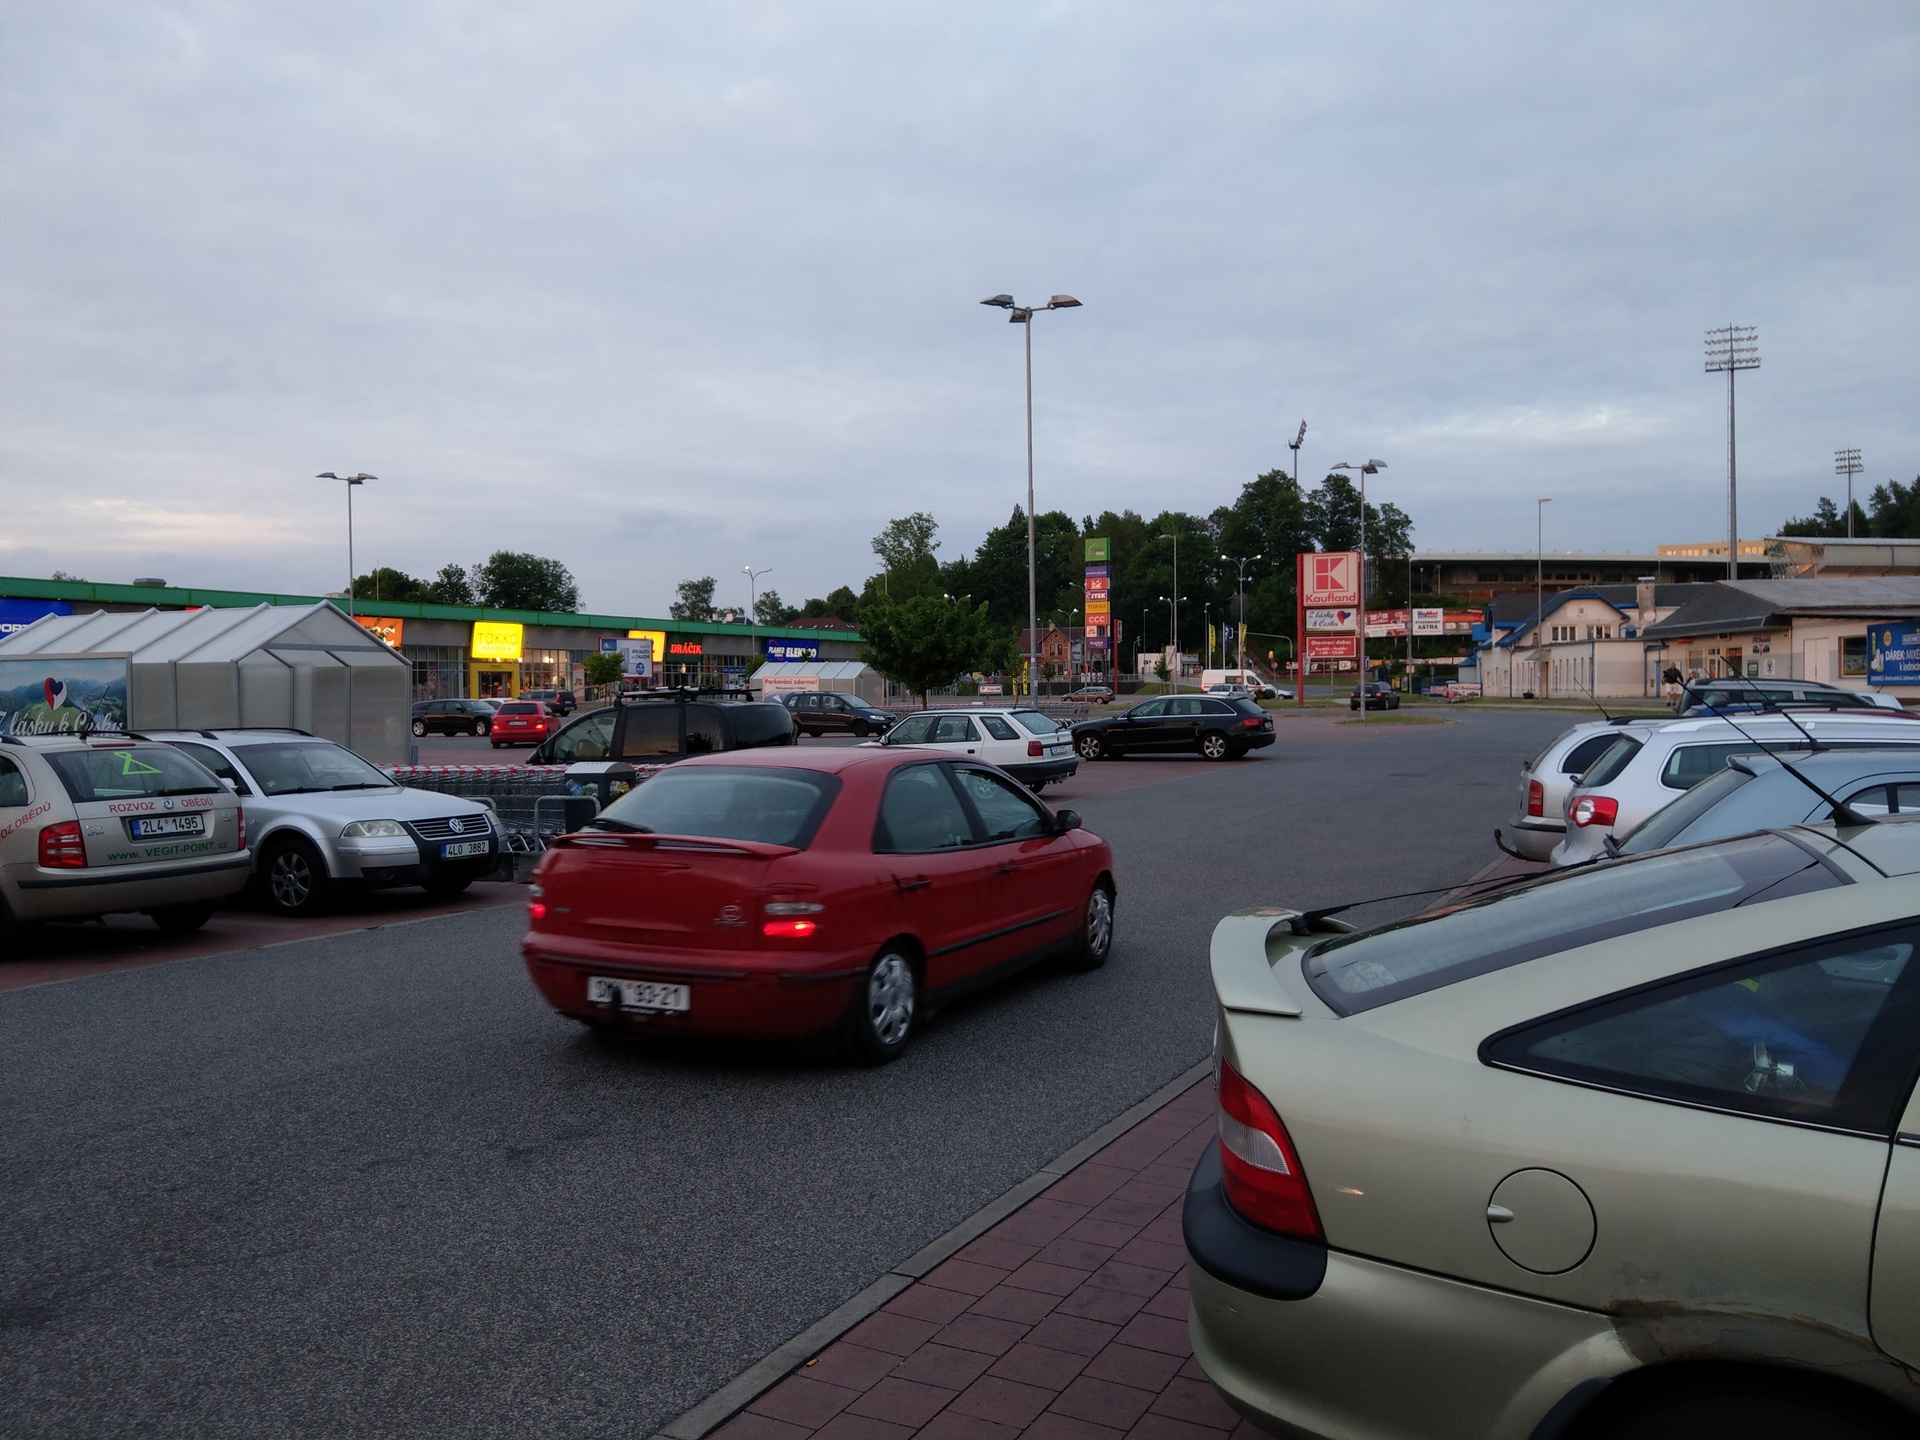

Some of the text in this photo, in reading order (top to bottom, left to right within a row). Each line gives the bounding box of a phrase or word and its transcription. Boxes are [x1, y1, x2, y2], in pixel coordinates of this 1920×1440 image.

[1090, 592, 1106, 600] JYSK
[1305, 593, 1356, 603] Kaufland
[670, 641, 703, 655] DRÁČIK
[109, 797, 214, 813] ROZVOZ OBĚDŮ
[15, 801, 51, 829] OBĚDŮ
[142, 816, 199, 834] 2L4 1495
